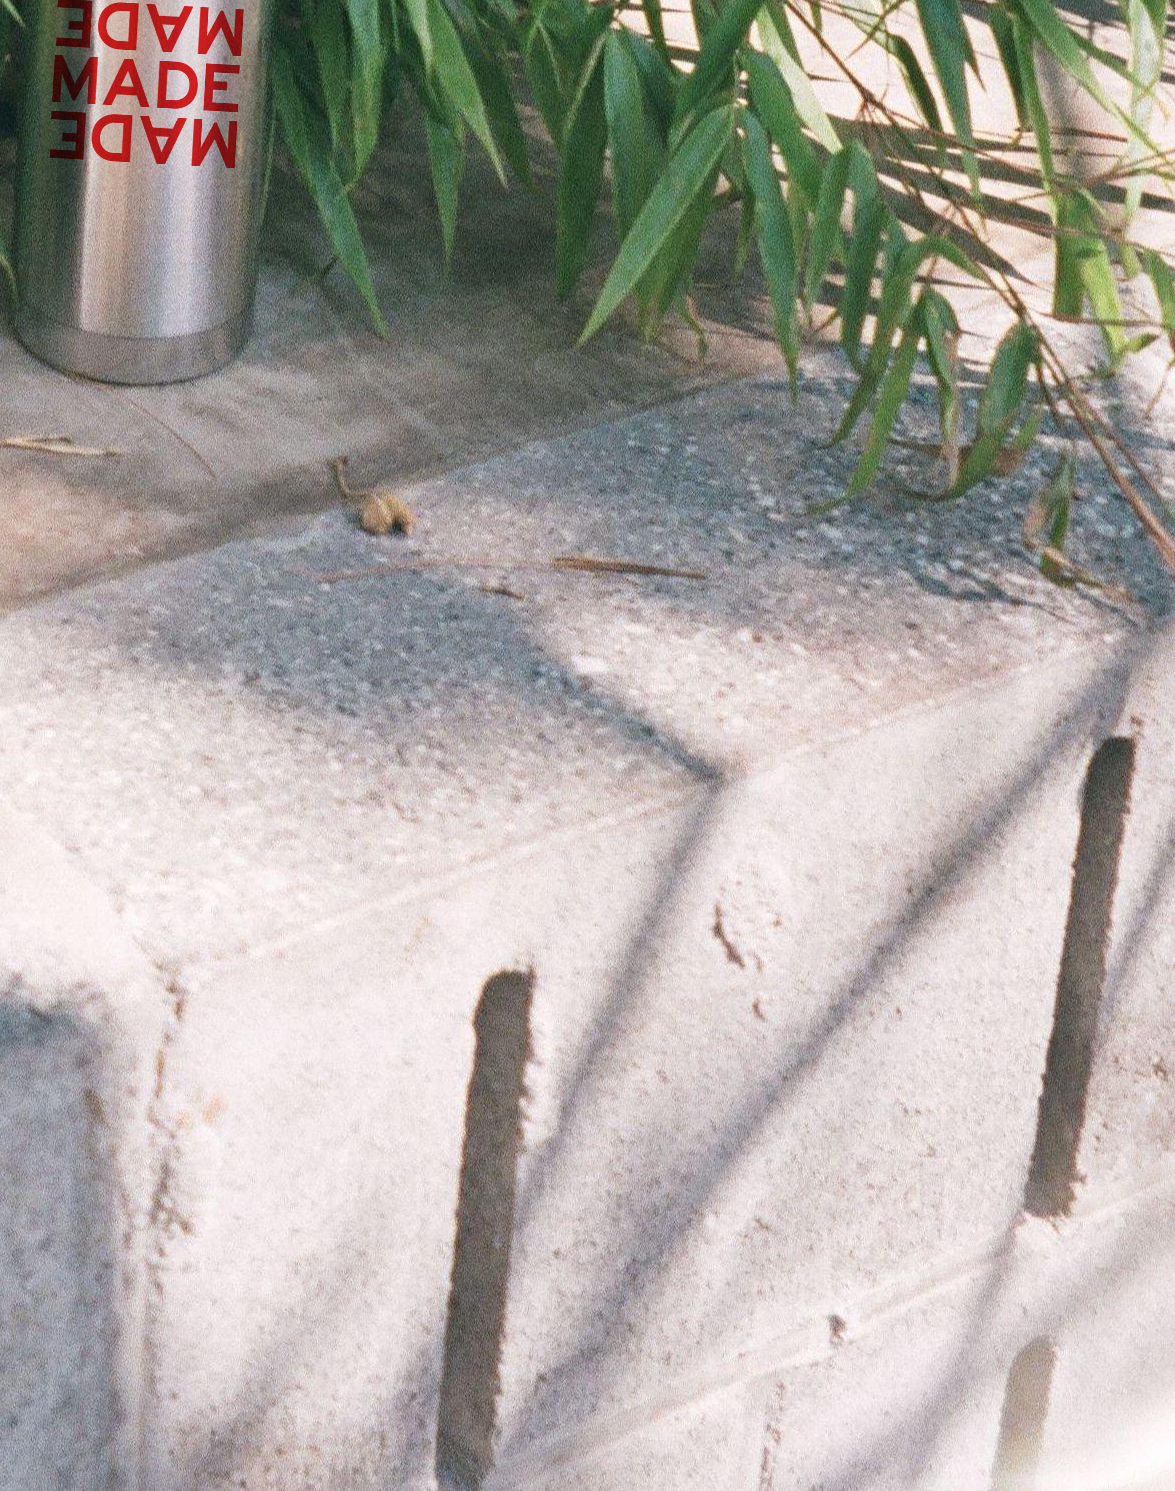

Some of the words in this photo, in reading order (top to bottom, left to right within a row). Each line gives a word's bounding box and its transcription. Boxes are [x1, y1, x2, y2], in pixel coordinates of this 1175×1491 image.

[56, 0, 244, 57] MADE
[51, 54, 240, 113] MADE
[49, 110, 238, 169] MADE
